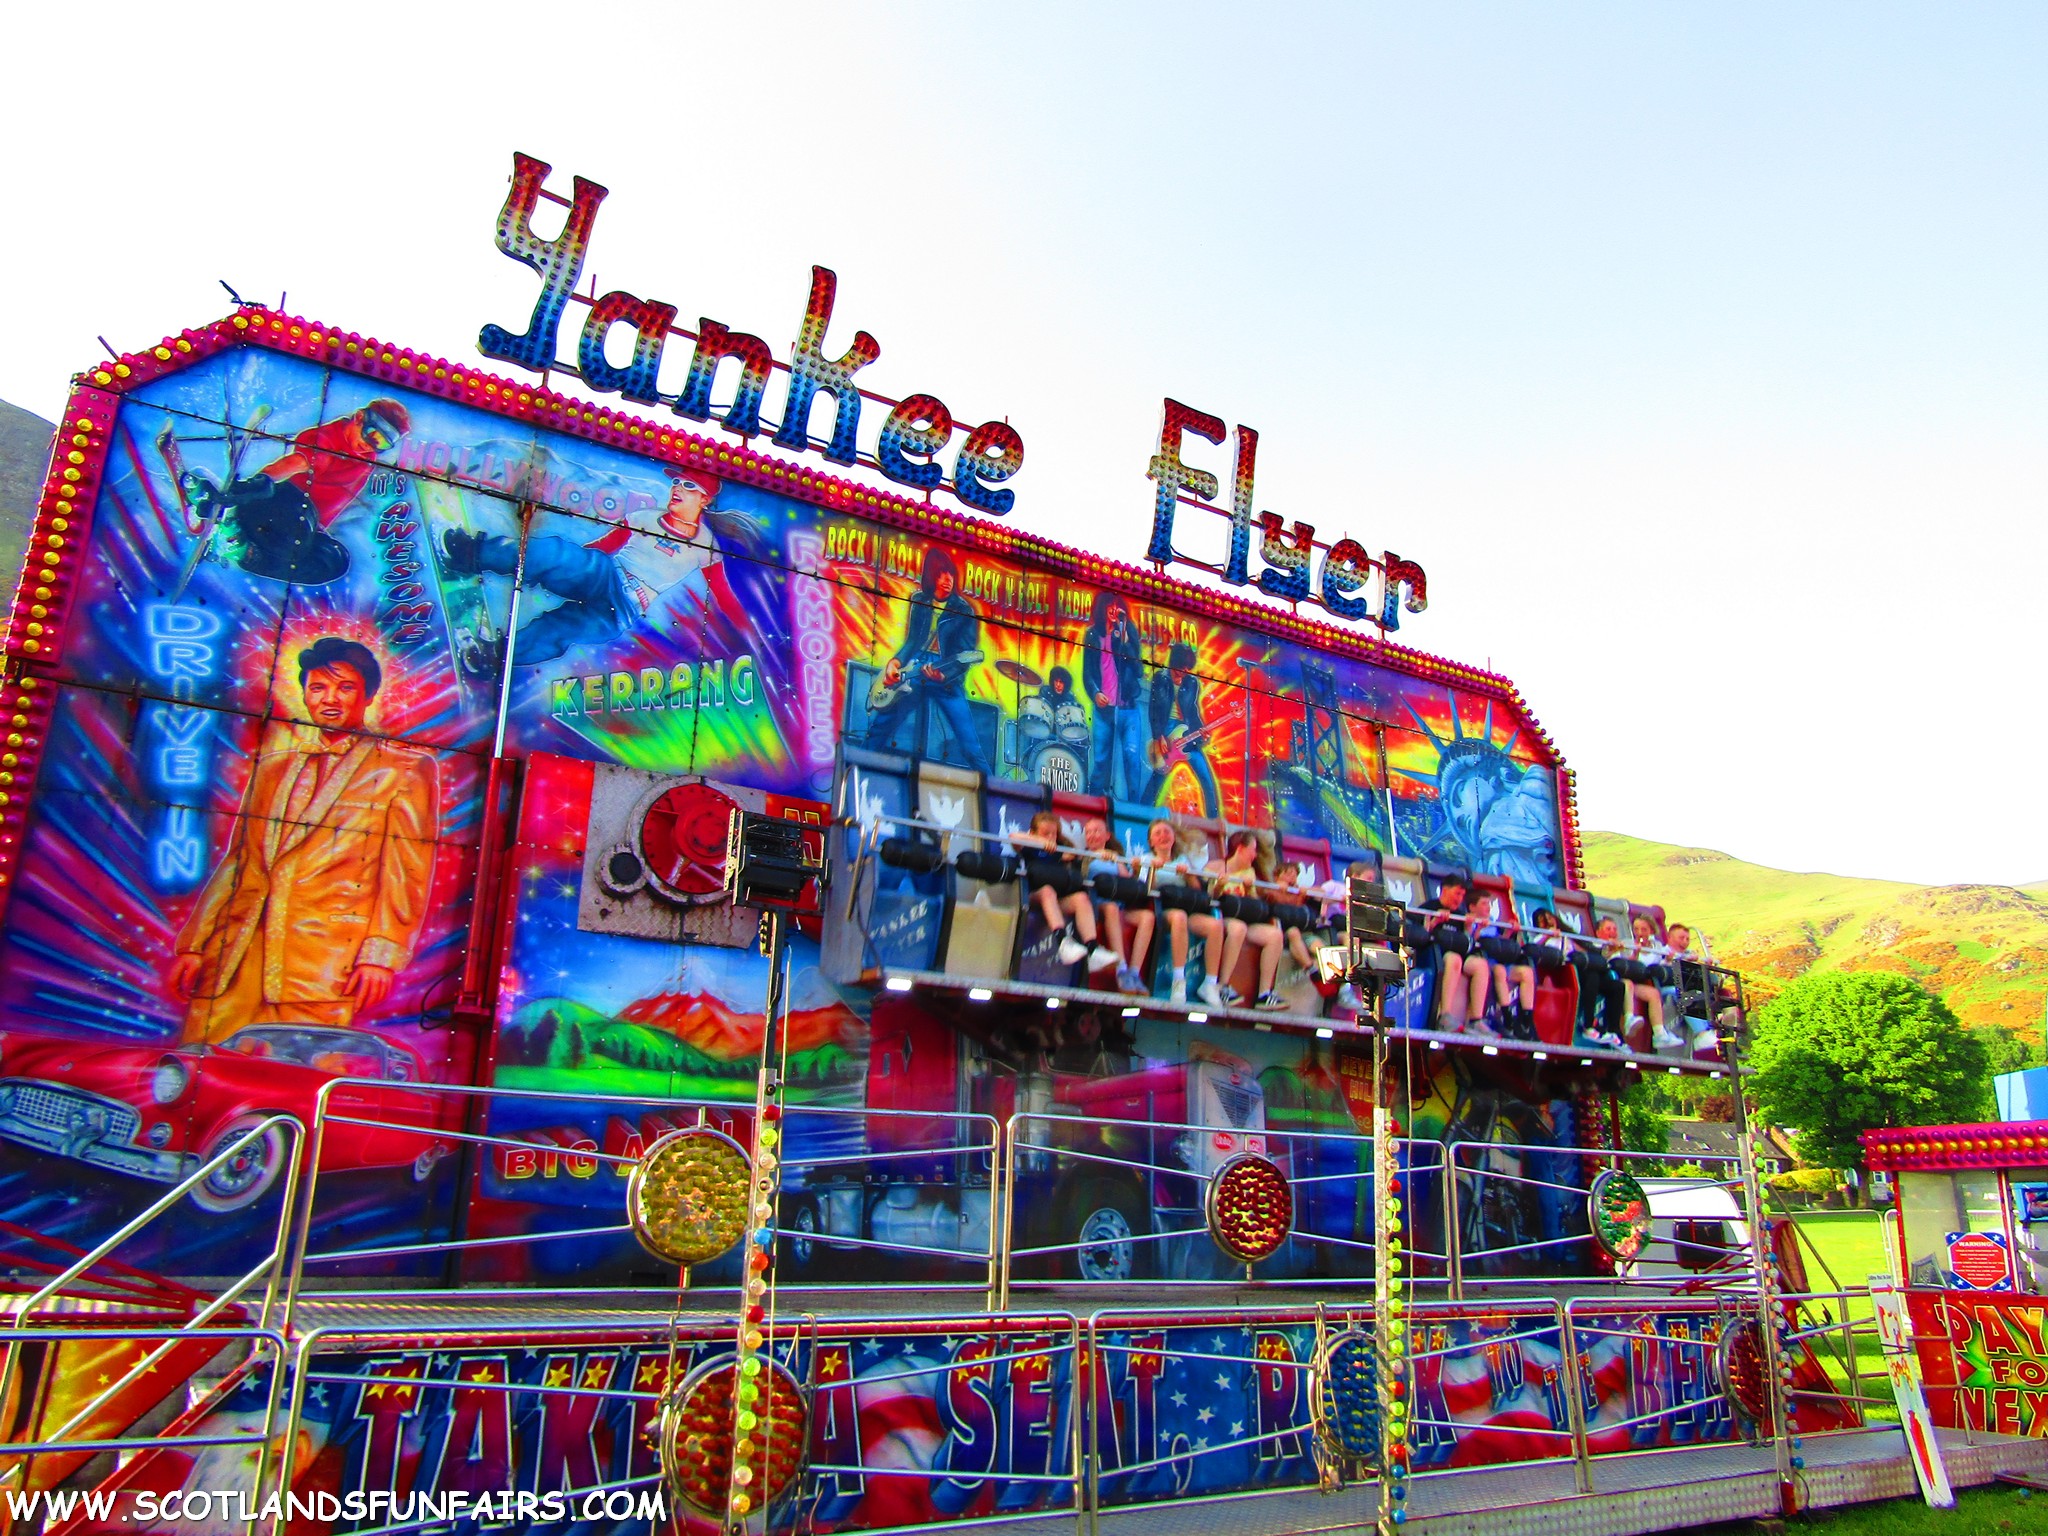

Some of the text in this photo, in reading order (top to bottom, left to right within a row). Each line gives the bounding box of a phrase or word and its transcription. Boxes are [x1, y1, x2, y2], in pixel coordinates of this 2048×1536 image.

[477, 152, 1428, 632] Yankee Flyer
[369, 473, 407, 496] IT'S
[376, 501, 435, 645] AWESOME
[824, 526, 867, 564] ROCK
[886, 539, 923, 583] ROLL
[963, 560, 1001, 605] ROCK
[1004, 576, 1014, 608] N
[1056, 588, 1092, 622] RADIO
[1179, 619, 1199, 652] GO
[150, 604, 222, 784] DRIVE
[551, 654, 755, 718] KERRANG
[1050, 757, 1071, 771] THE
[157, 803, 201, 881] IN
[504, 1138, 599, 1179] BIG
[1933, 1303, 2048, 1357] PAY
[1543, 1348, 1599, 1426] TE
